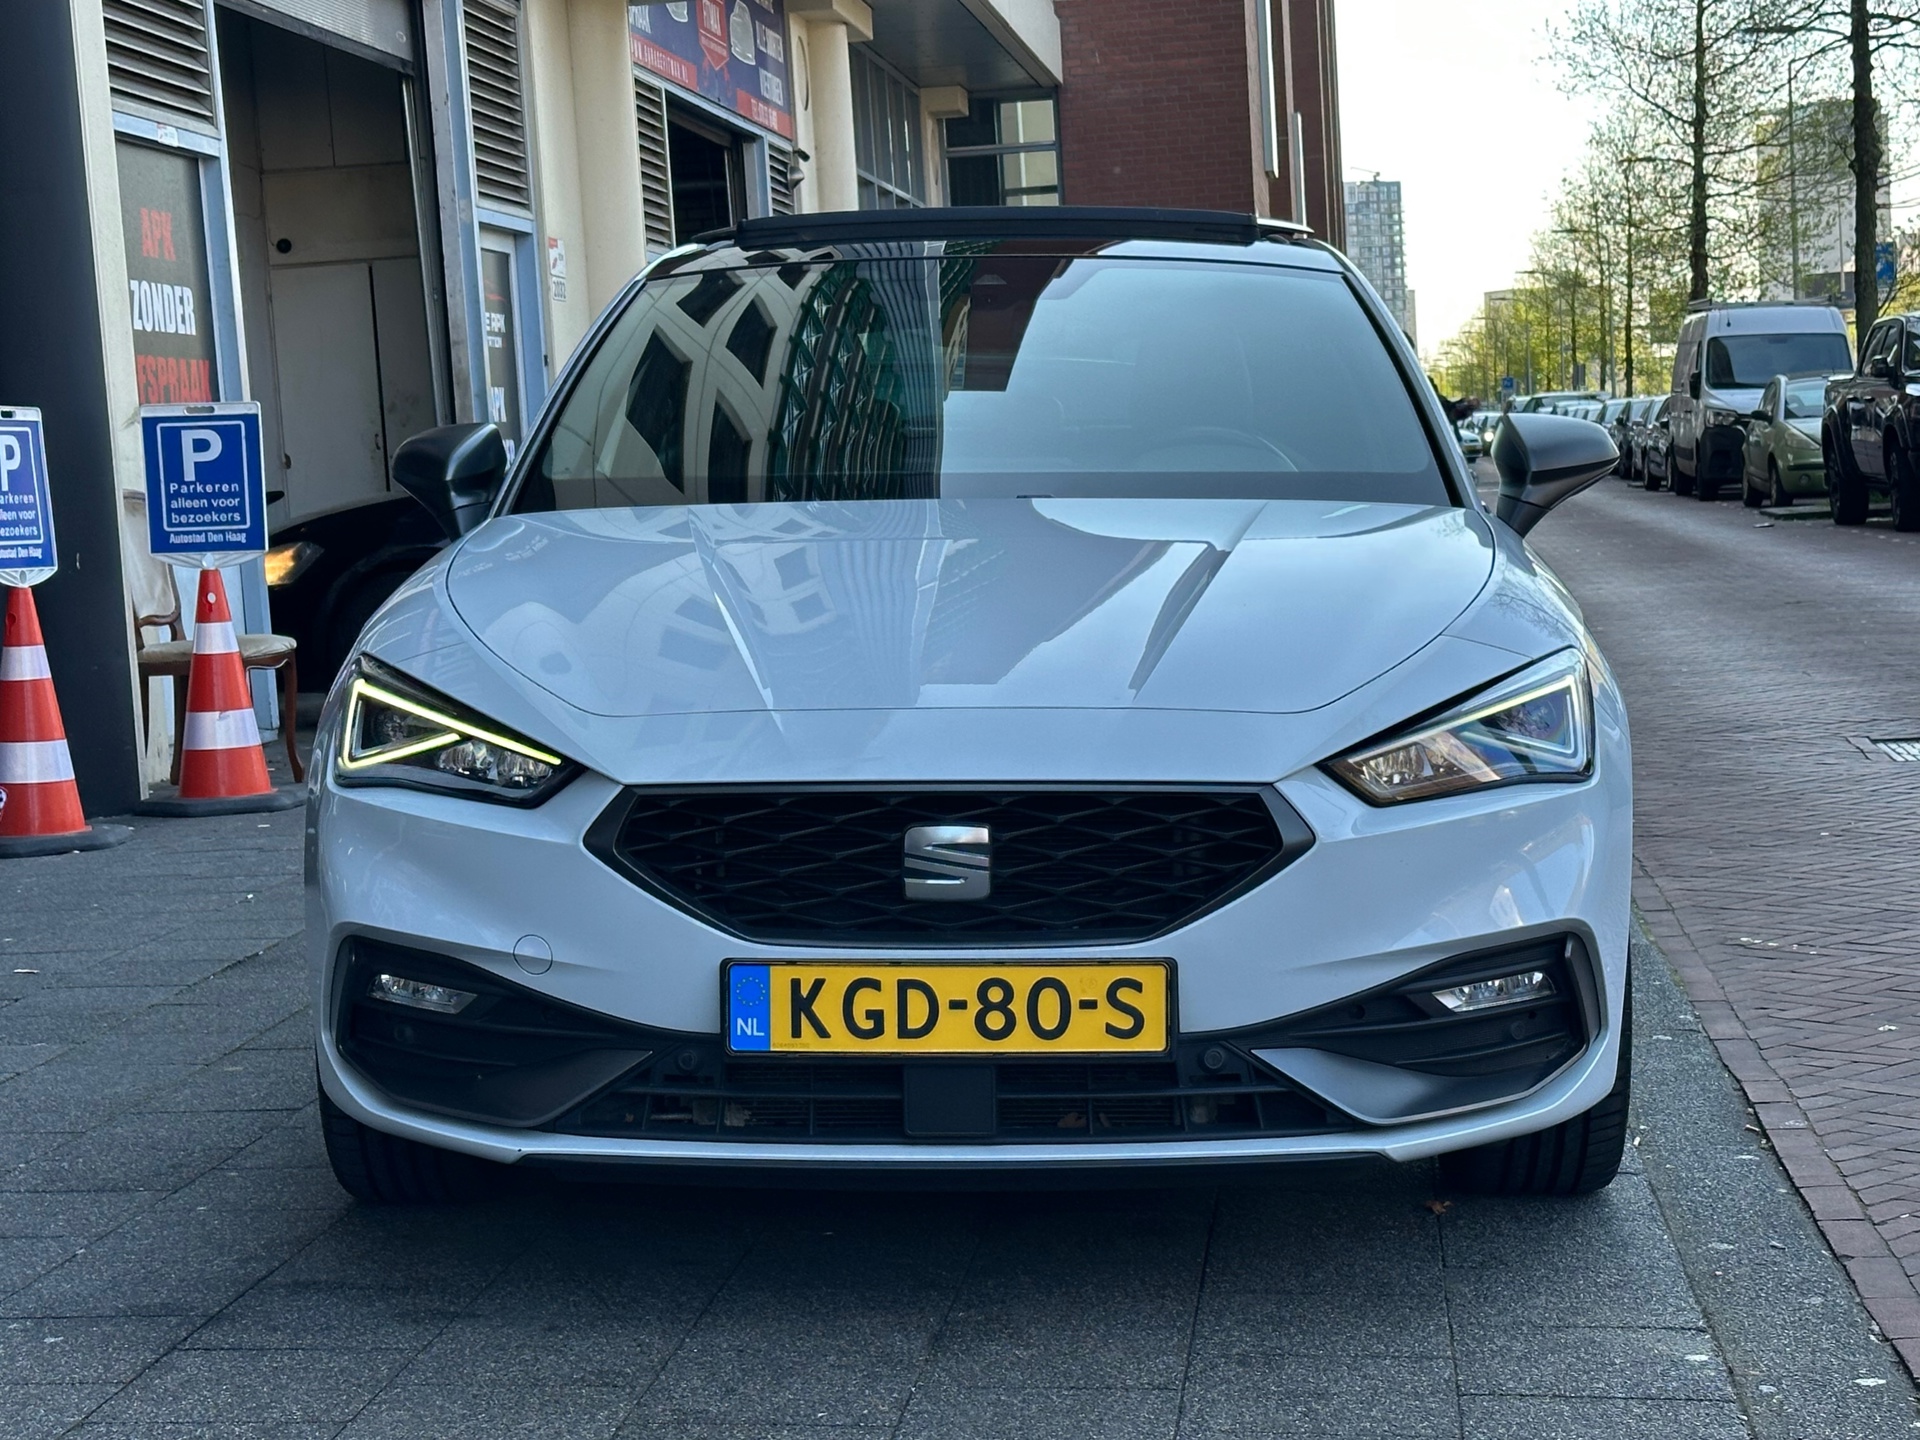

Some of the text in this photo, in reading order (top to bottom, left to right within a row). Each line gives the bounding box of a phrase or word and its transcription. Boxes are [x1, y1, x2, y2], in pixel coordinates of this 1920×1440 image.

[140, 207, 176, 261] APK
[130, 279, 196, 336] ZONDER
[136, 354, 213, 403] FSPRAAK
[181, 429, 223, 482] P
[170, 482, 240, 494] Parkeren
[0, 492, 35, 505] arkeren
[170, 497, 240, 509] alleen voor
[18, 510, 36, 520] voor
[171, 510, 241, 523] bezoekers
[0, 524, 39, 537] ezoekers
[169, 531, 247, 544] Autostad Den Haag
[789, 976, 1146, 1041] KGD-80-S
[736, 1018, 765, 1038] NL
